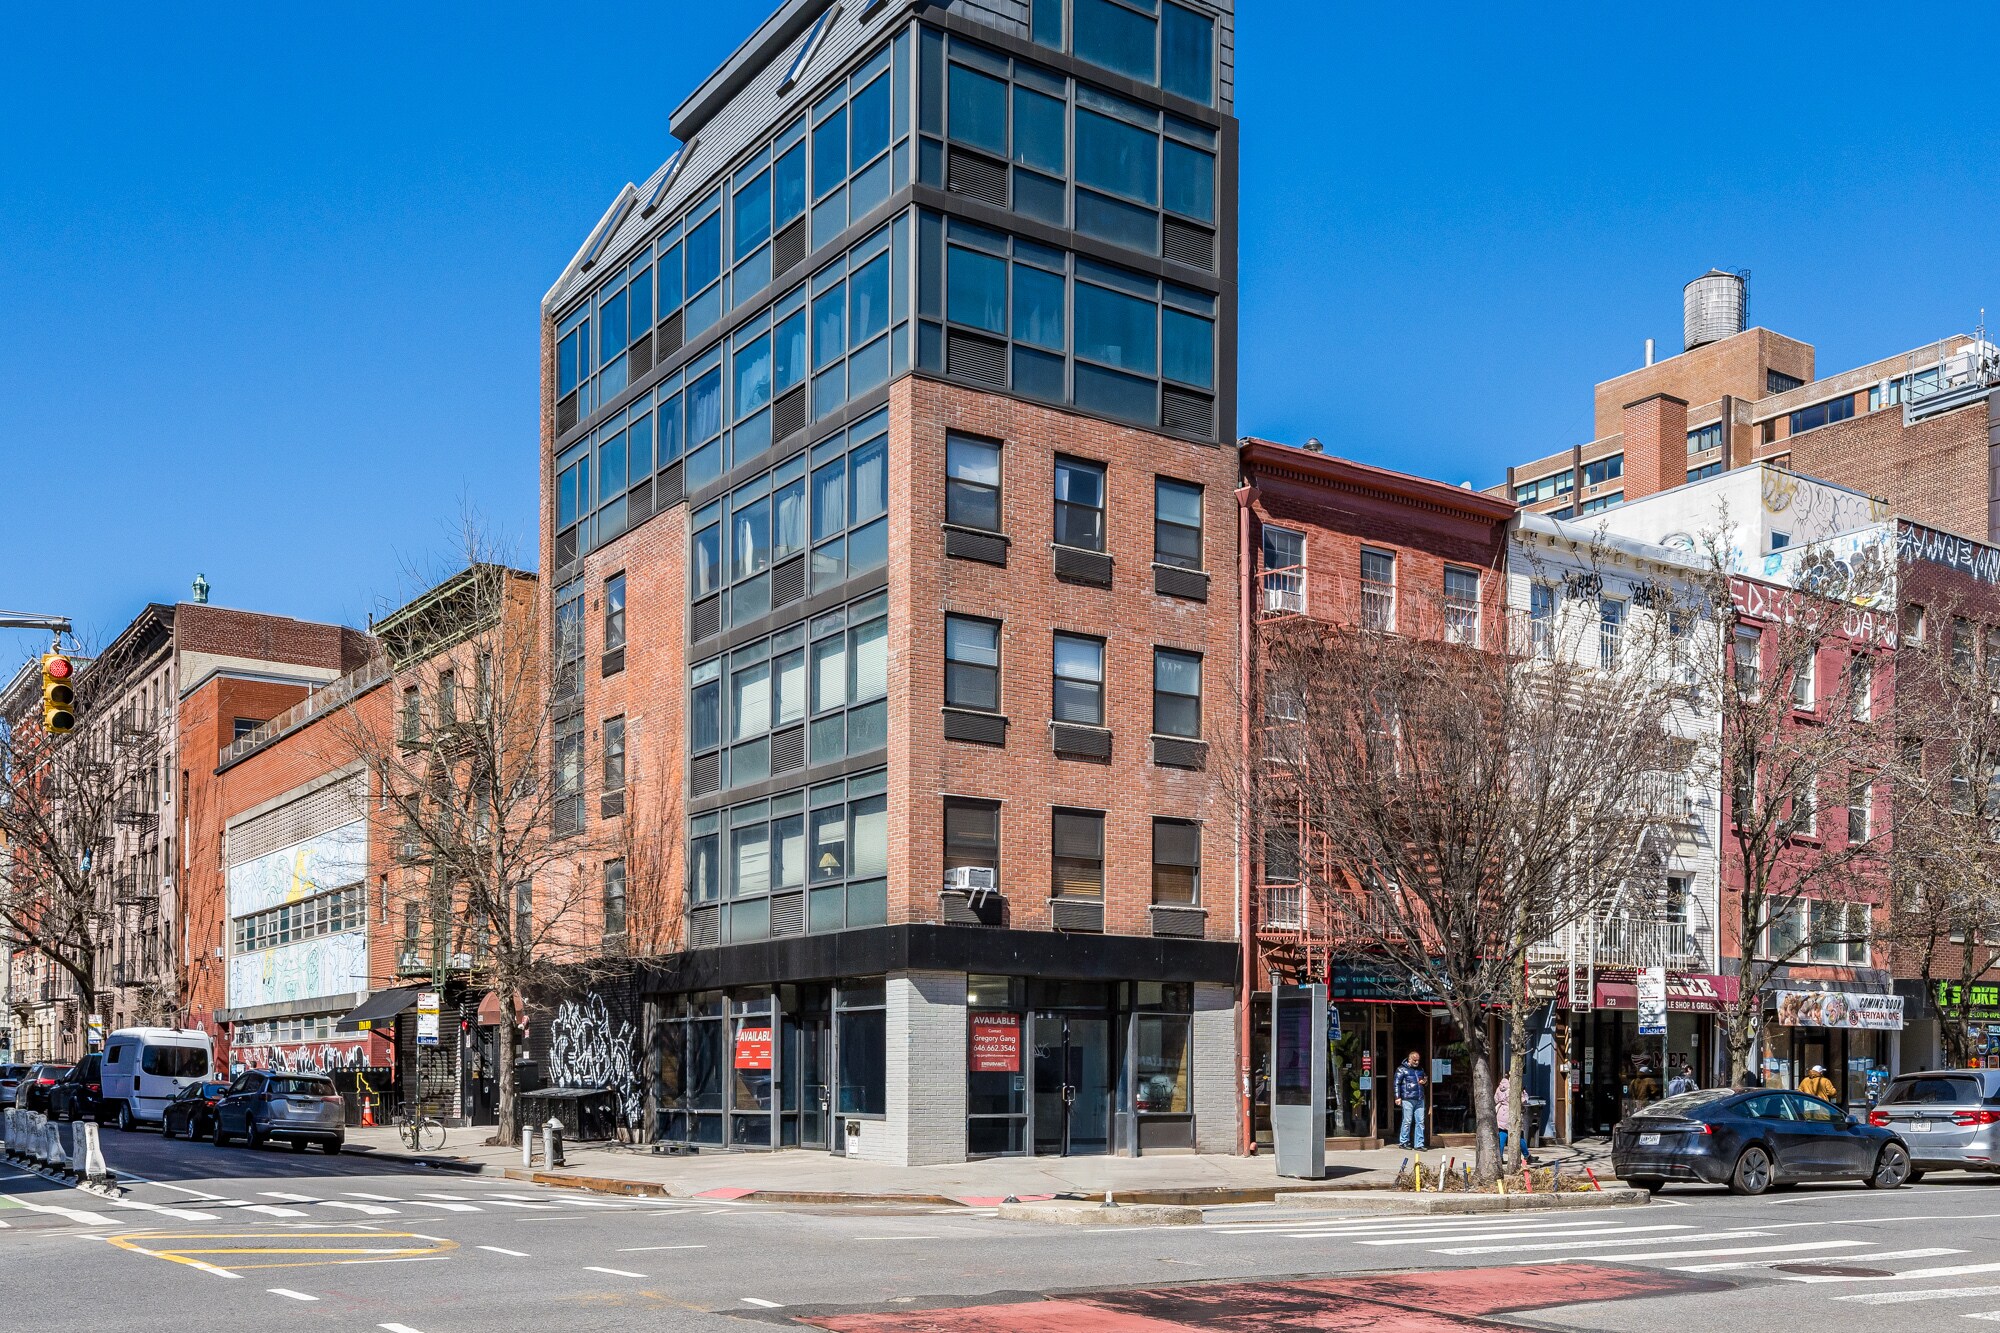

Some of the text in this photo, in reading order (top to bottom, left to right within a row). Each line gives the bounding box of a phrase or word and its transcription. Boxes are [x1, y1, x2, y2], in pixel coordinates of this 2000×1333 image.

[1952, 985, 1998, 1005] SOKE
[1607, 998, 1616, 1006] 223
[1859, 997, 1884, 1009] COMING
[1859, 1011, 1887, 1020] TERIYAKI
[740, 1031, 772, 1041] AVAILABL
[974, 1035, 1016, 1044] Gregory Gang
